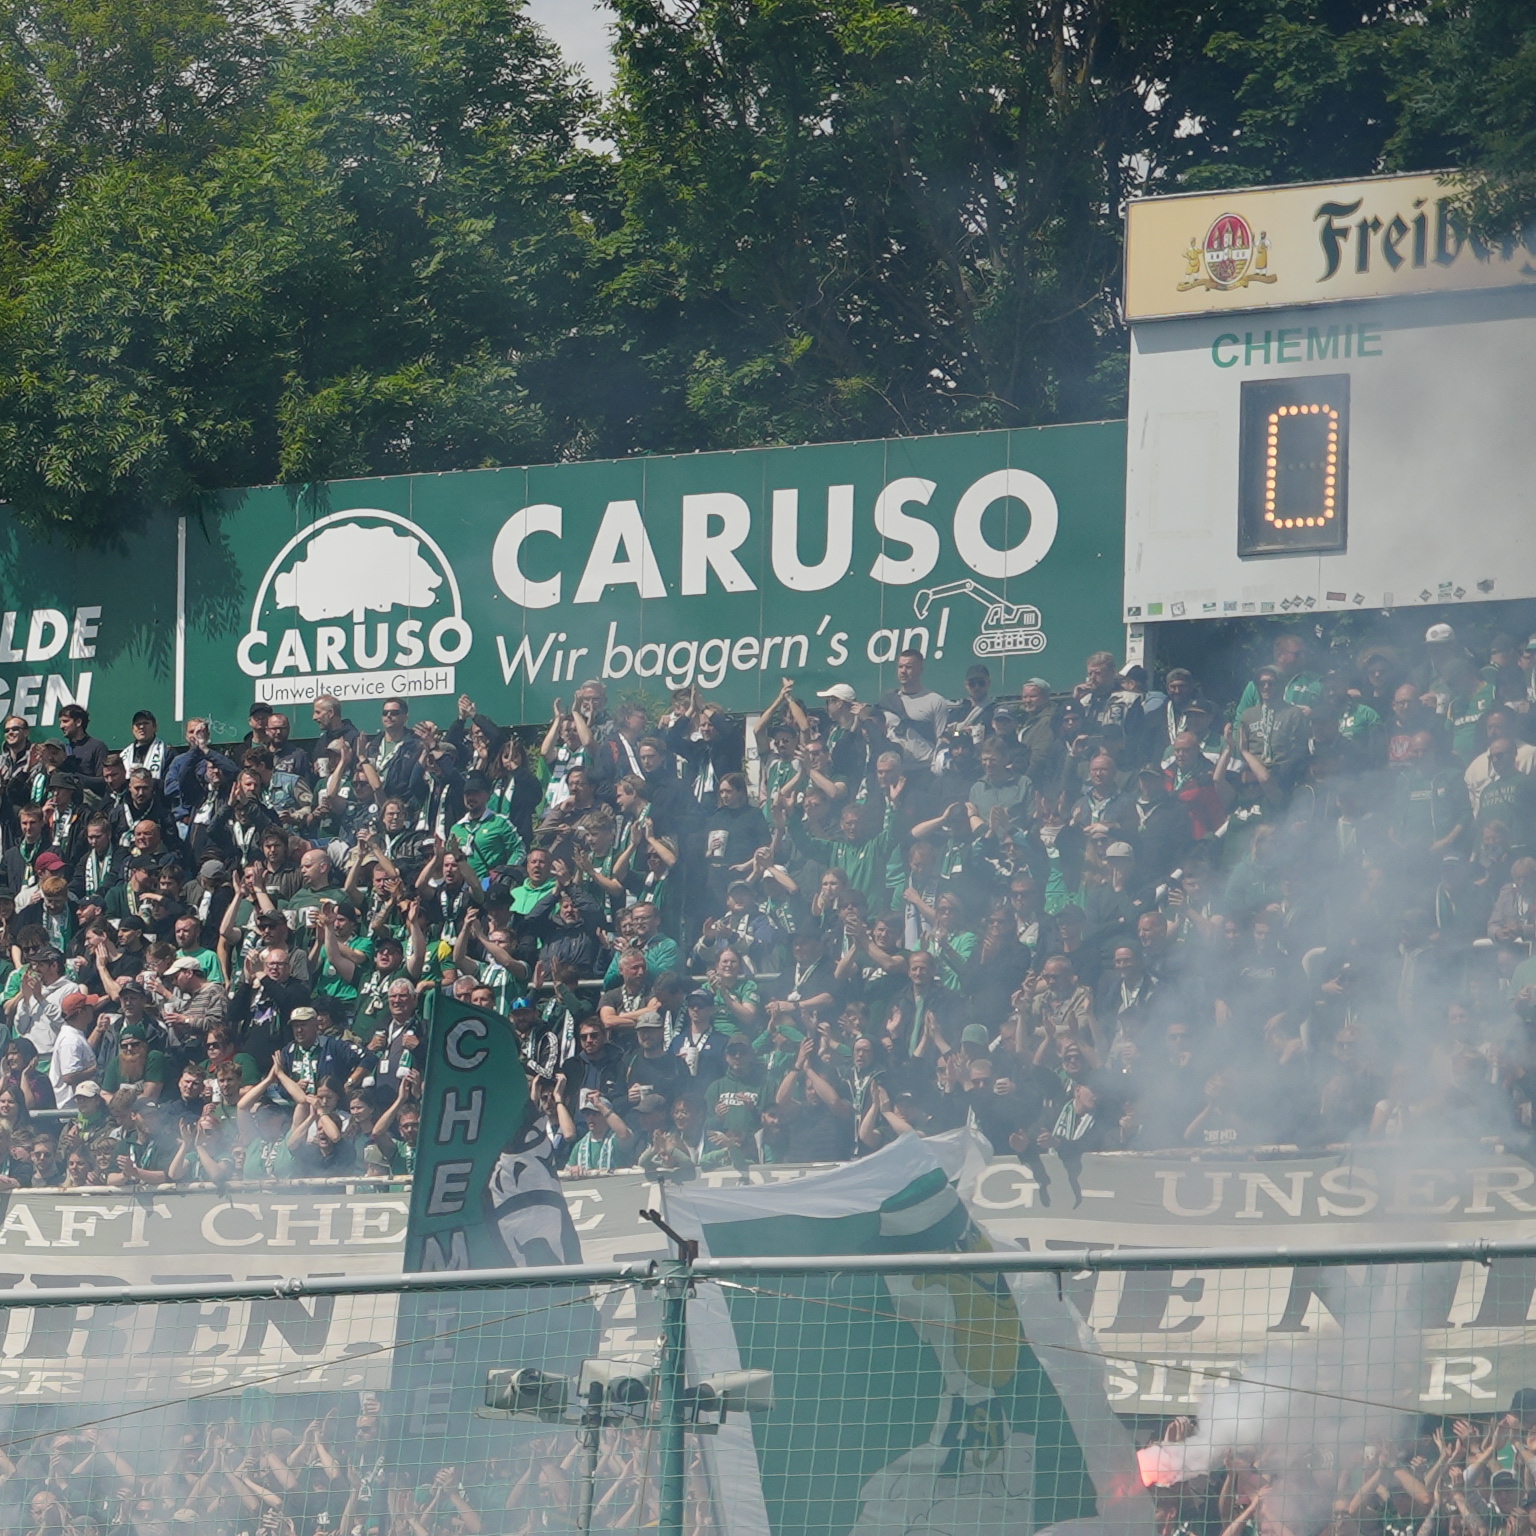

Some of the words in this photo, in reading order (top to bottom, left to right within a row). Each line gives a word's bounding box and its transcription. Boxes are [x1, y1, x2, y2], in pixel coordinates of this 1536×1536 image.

[1314, 196, 1536, 284] Freib
[1211, 323, 1384, 369] CHEMIE
[1264, 401, 1339, 530] 0
[492, 468, 1060, 609] CARUSO
[237, 616, 474, 677] CARUSO
[261, 677, 385, 702] Umweltservice
[391, 671, 449, 694] GmbH
[496, 632, 588, 686] Wir
[603, 613, 850, 690] baggern's
[868, 606, 947, 664] an!
